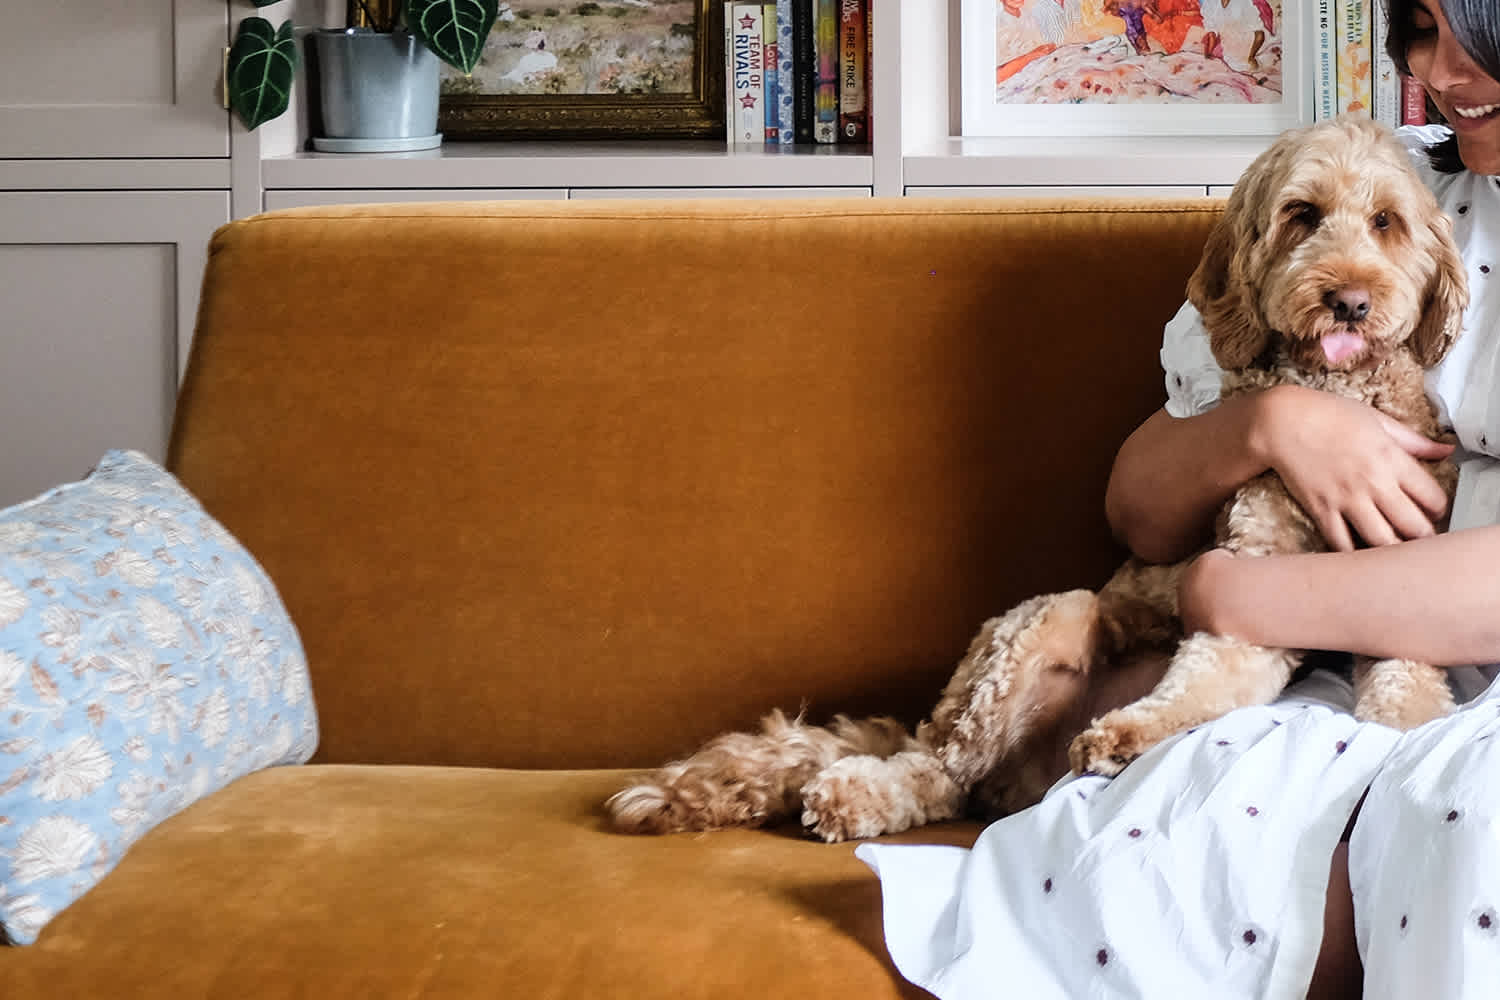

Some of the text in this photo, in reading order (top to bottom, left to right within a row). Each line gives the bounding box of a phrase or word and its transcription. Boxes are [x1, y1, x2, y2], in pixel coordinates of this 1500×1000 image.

[1320, 17, 1328, 29] NG
[1320, 32, 1328, 49] OUR
[735, 34, 749, 89] RIVALS
[750, 34, 761, 89] TEAM OF
[846, 26, 855, 89] FIRE STRIKE
[1321, 52, 1330, 87] MISSING
